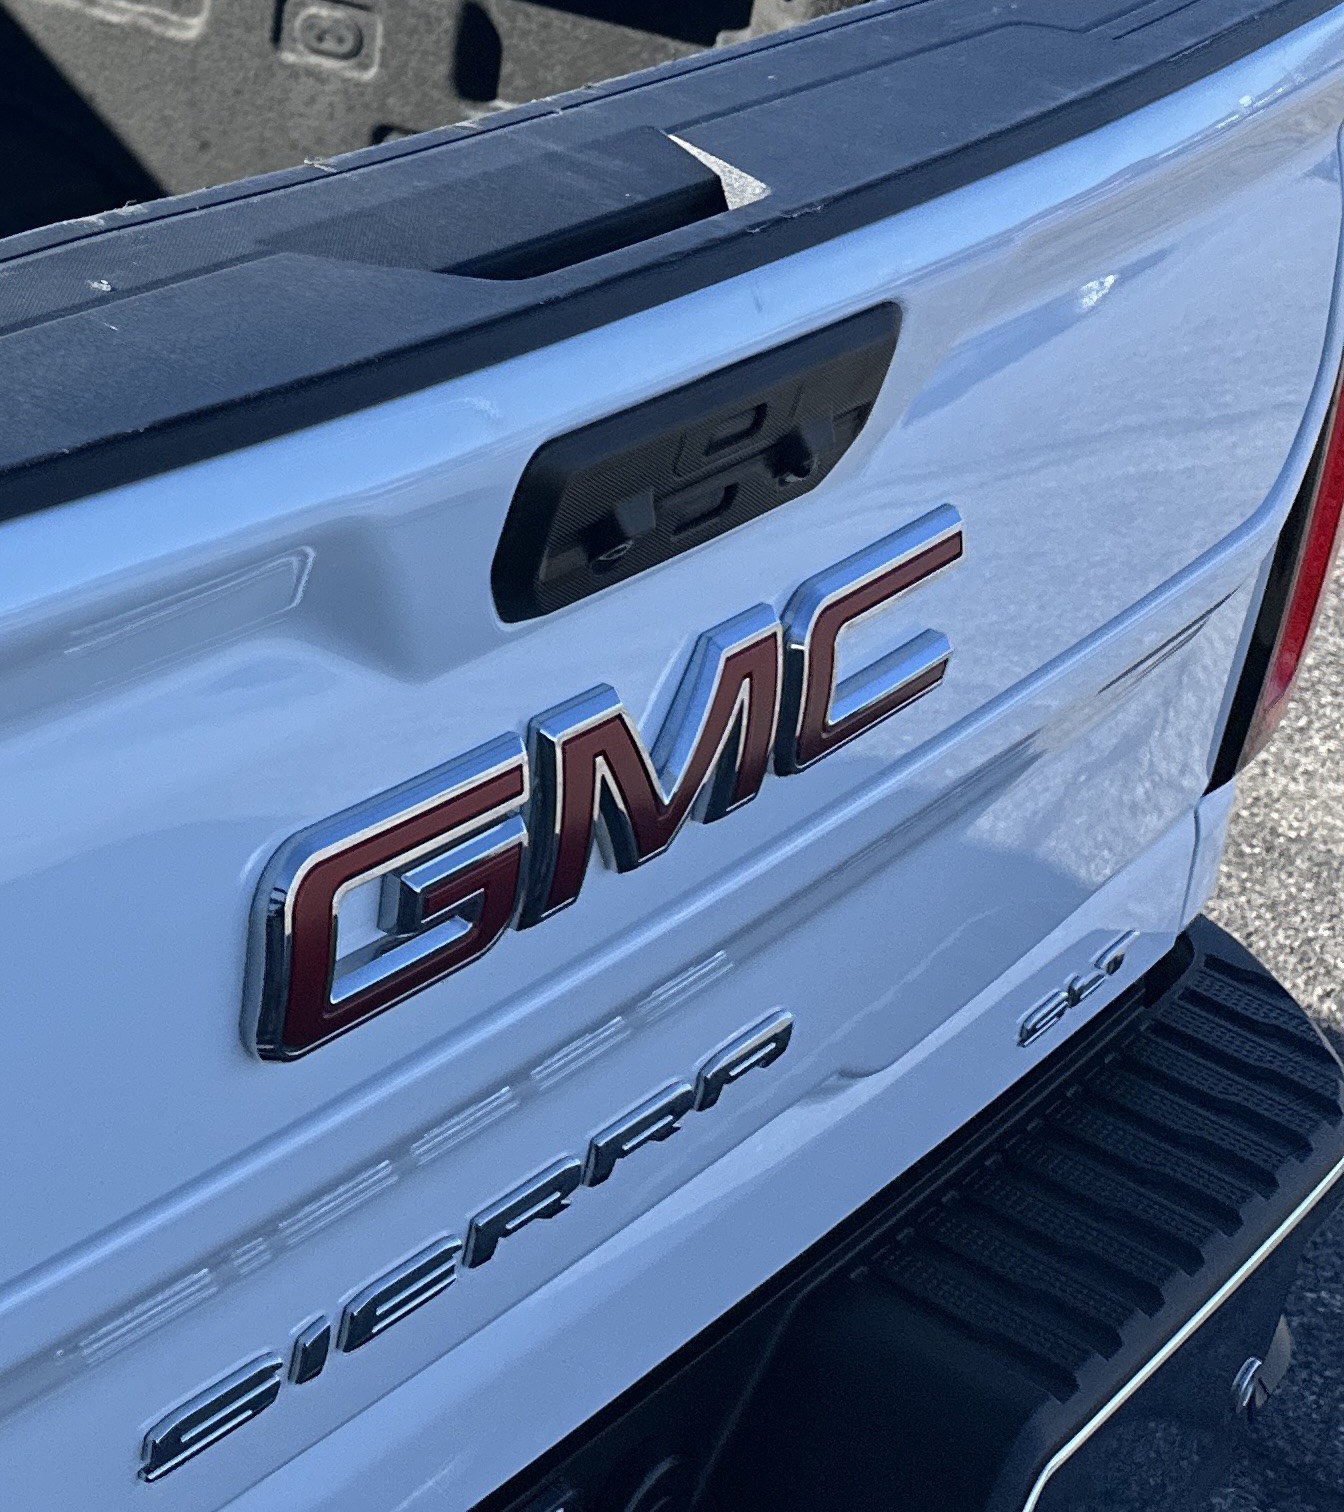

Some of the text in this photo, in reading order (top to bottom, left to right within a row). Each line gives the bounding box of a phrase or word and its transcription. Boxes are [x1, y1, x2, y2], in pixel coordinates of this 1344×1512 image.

[246, 502, 965, 1063] GMC
[1015, 928, 1141, 1049] SLT
[138, 1007, 795, 1483] SIERRA
